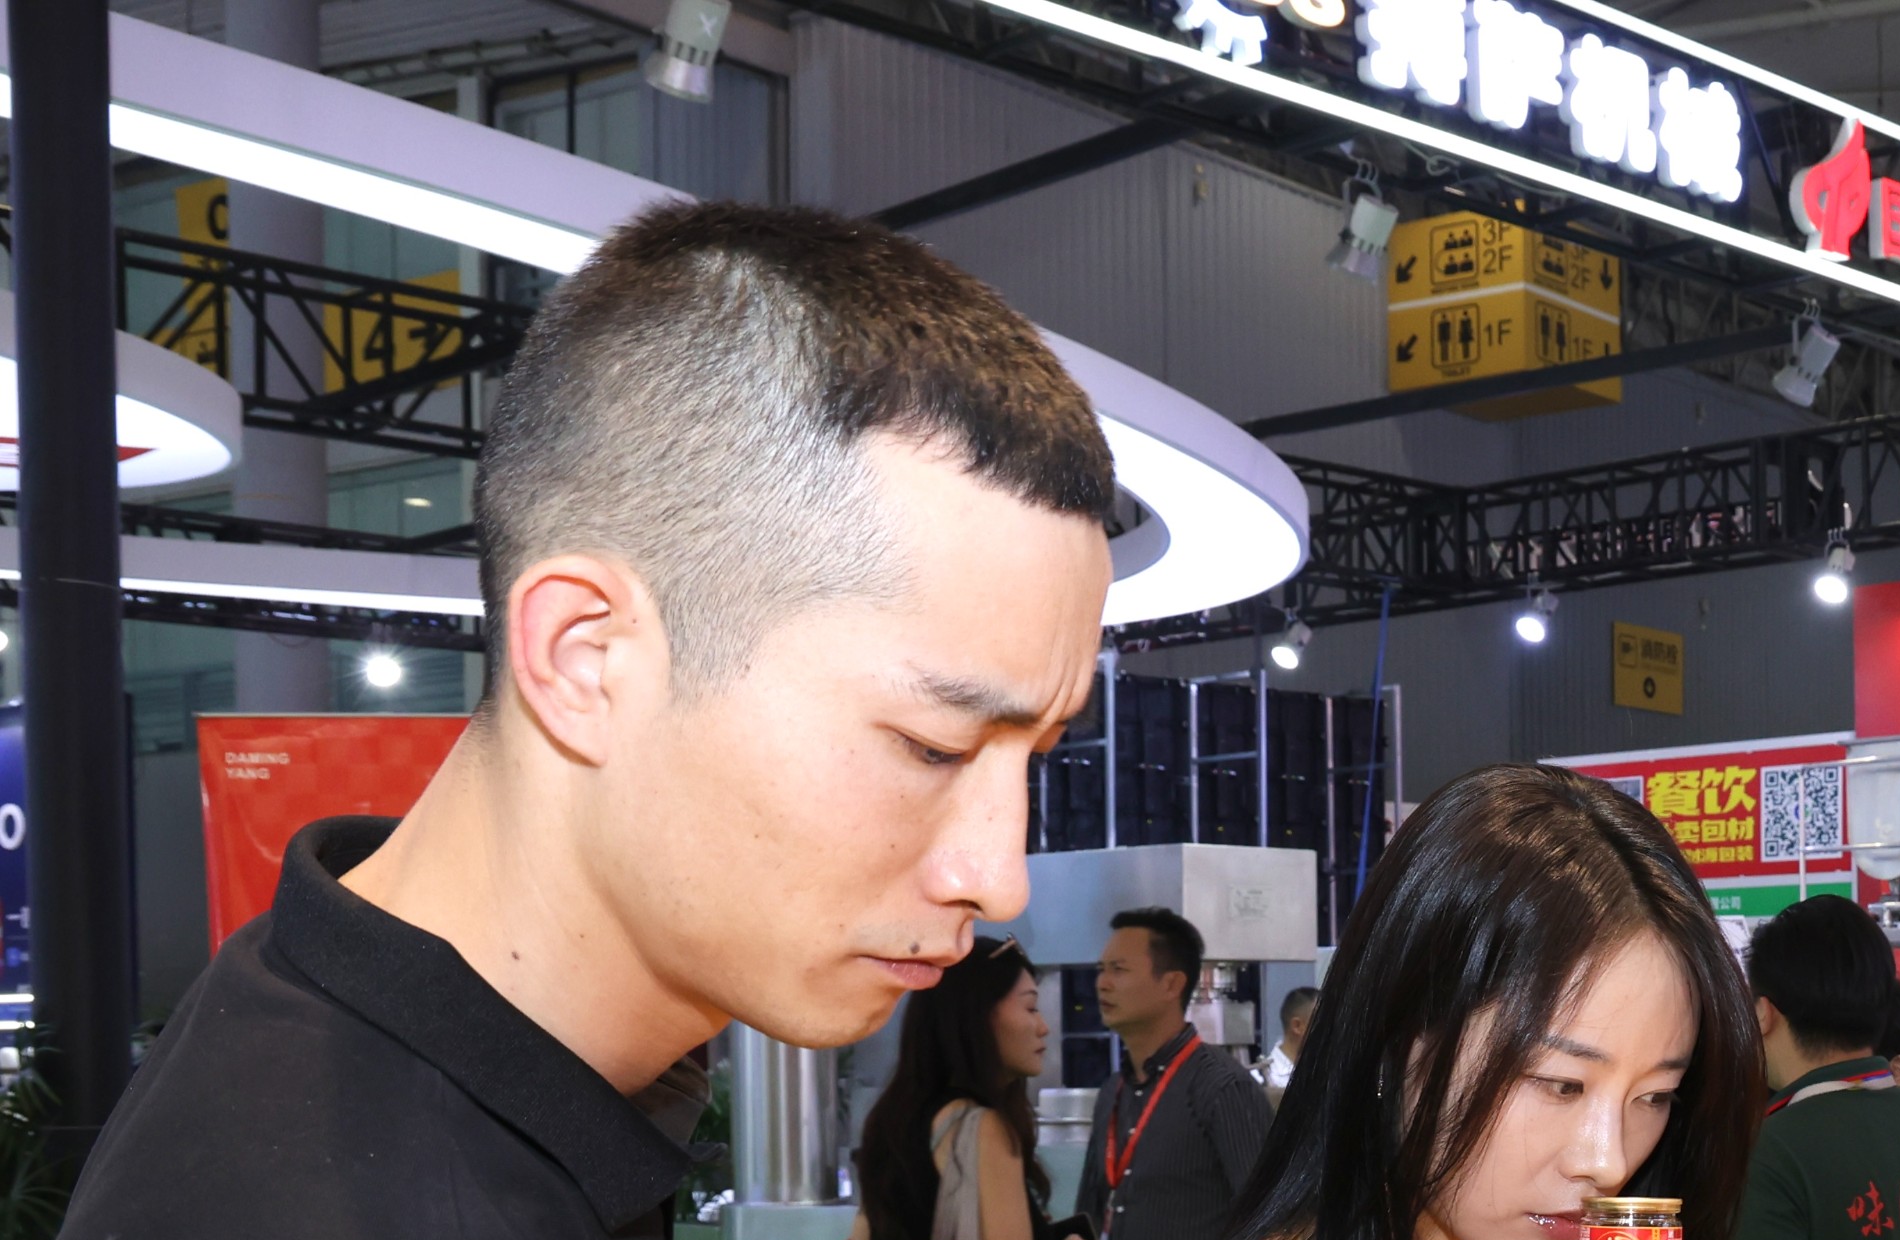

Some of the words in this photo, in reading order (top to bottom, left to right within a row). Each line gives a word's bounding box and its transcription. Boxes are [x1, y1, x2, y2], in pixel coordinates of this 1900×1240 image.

[1483, 245, 1513, 274] 2F
[1484, 318, 1513, 347] 1F
[1647, 765, 1757, 818] 餐饮
[1669, 817, 1755, 844] 卖包材
